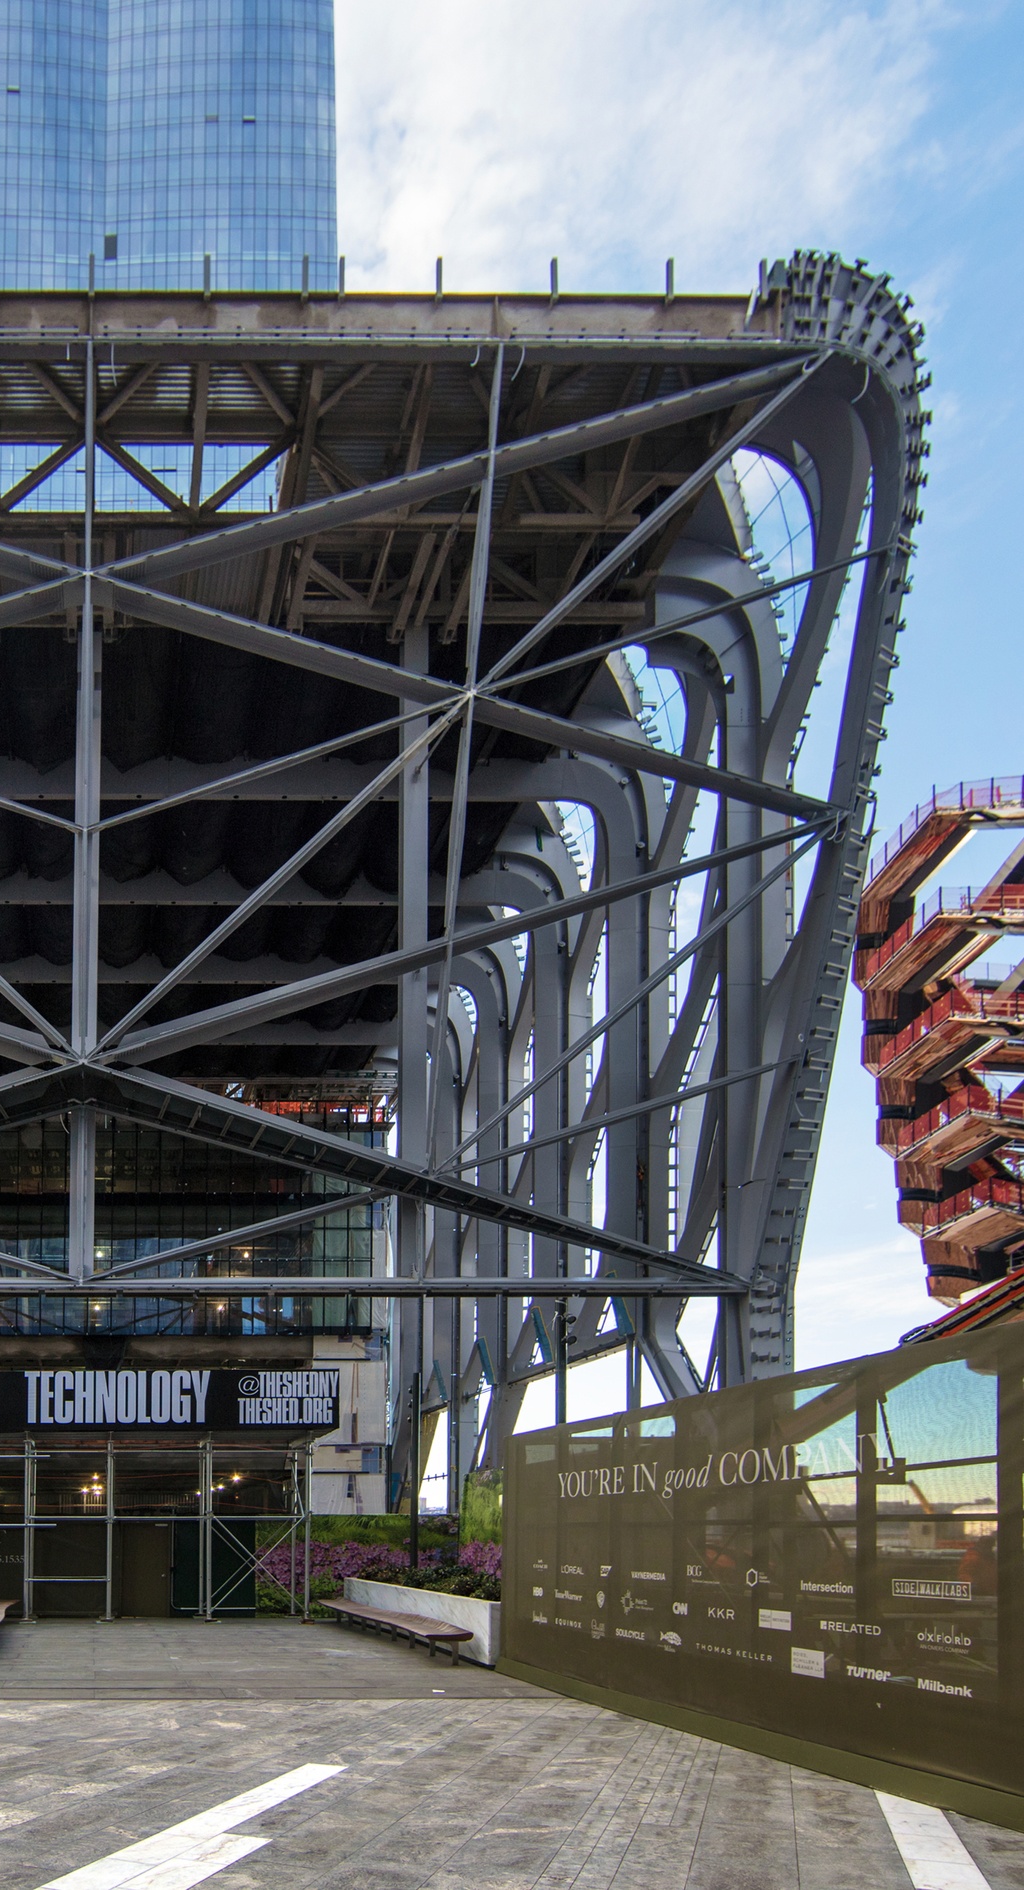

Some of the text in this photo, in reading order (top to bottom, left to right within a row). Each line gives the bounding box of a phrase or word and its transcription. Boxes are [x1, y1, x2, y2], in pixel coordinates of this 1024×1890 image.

[238, 1371, 339, 1398] @THESHEDNY
[24, 1370, 211, 1424] TECHNOLOGY
[237, 1397, 333, 1424] THESHED.ORG
[632, 1462, 658, 1493] IN
[662, 1454, 712, 1499] good
[719, 1431, 893, 1486] COMPANY
[686, 1564, 703, 1577] BCG
[800, 1579, 854, 1595] Intersection
[894, 1581, 968, 1598] SIDE WALK LABS
[707, 1606, 736, 1621] KKR
[555, 1617, 582, 1629] EQUINOX
[828, 1621, 882, 1637] RELATED
[615, 1627, 646, 1641] SOULCYCLE
[695, 1642, 773, 1662] THOMAS KELLER
[846, 1665, 891, 1682] Turner
[917, 1678, 974, 1698] Milbank
